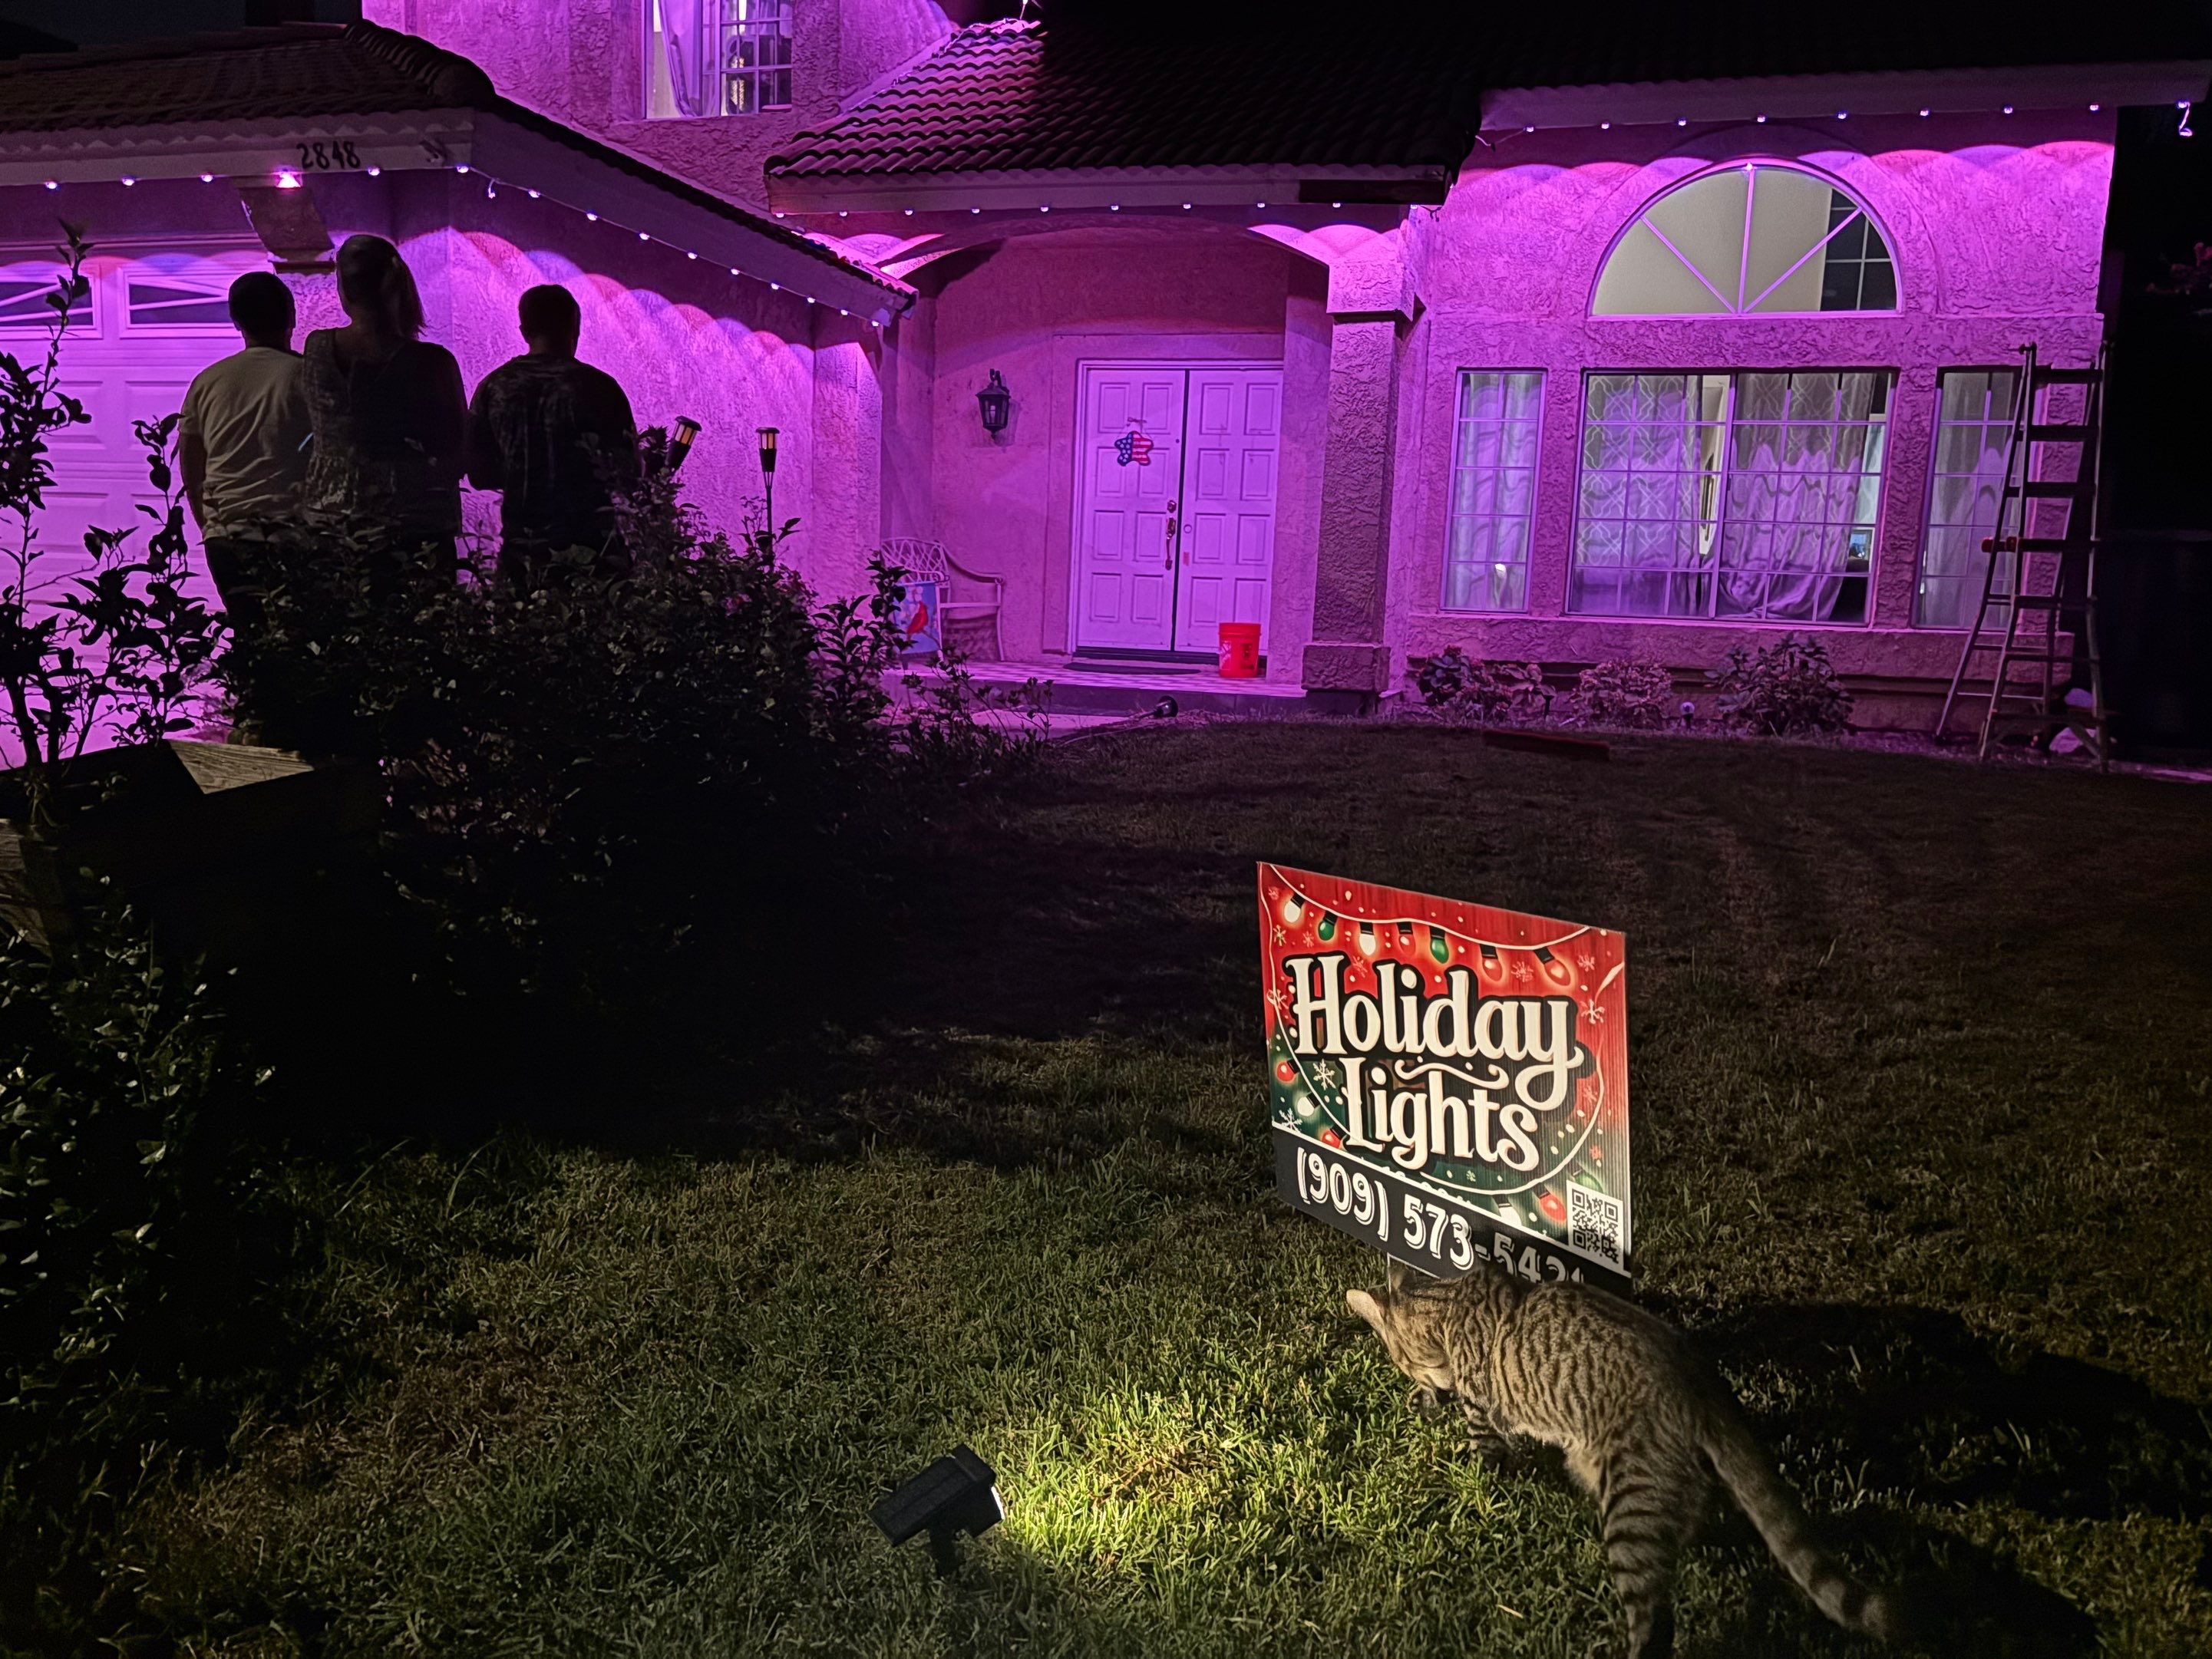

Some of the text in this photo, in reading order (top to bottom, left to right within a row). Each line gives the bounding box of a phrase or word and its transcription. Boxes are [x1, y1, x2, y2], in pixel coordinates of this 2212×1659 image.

[296, 140, 361, 169] 2848
[1285, 955, 1585, 1111] Holiday
[1339, 1057, 1540, 1172] Lights
[1296, 1146, 1390, 1242] (909)
